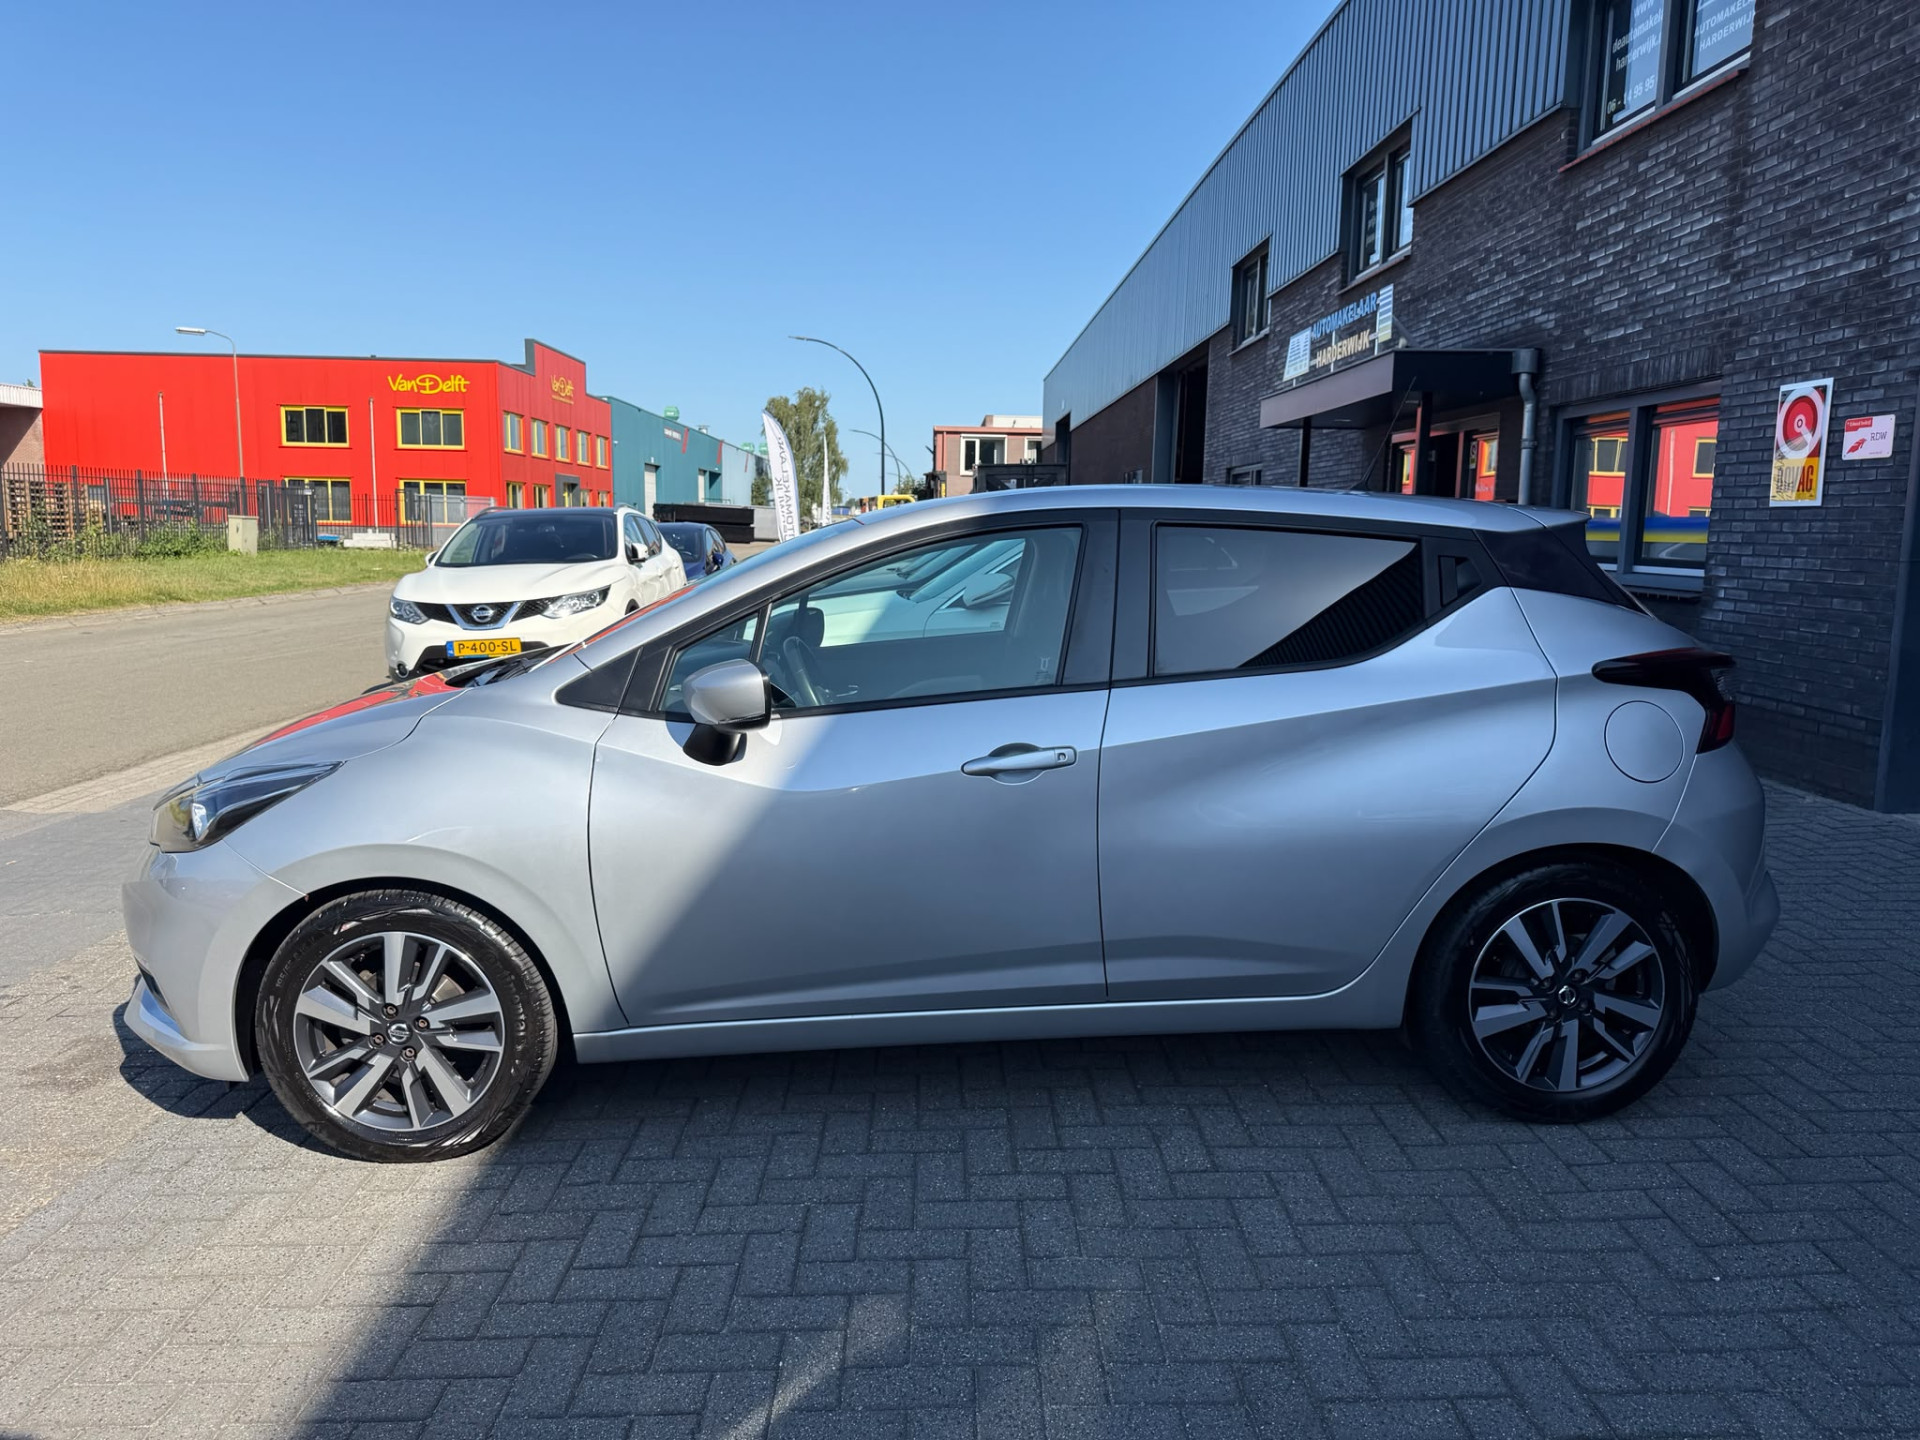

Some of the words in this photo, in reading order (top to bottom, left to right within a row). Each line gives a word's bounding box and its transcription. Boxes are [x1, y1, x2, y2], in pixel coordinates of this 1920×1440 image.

[1699, 9, 1753, 51] HARDERWIJ
[1311, 292, 1376, 340] AUTOMAKELAAR
[1316, 329, 1371, 369] HARDERWIJK
[1870, 431, 1888, 442] RDW
[458, 640, 517, 654] P-400-SL
